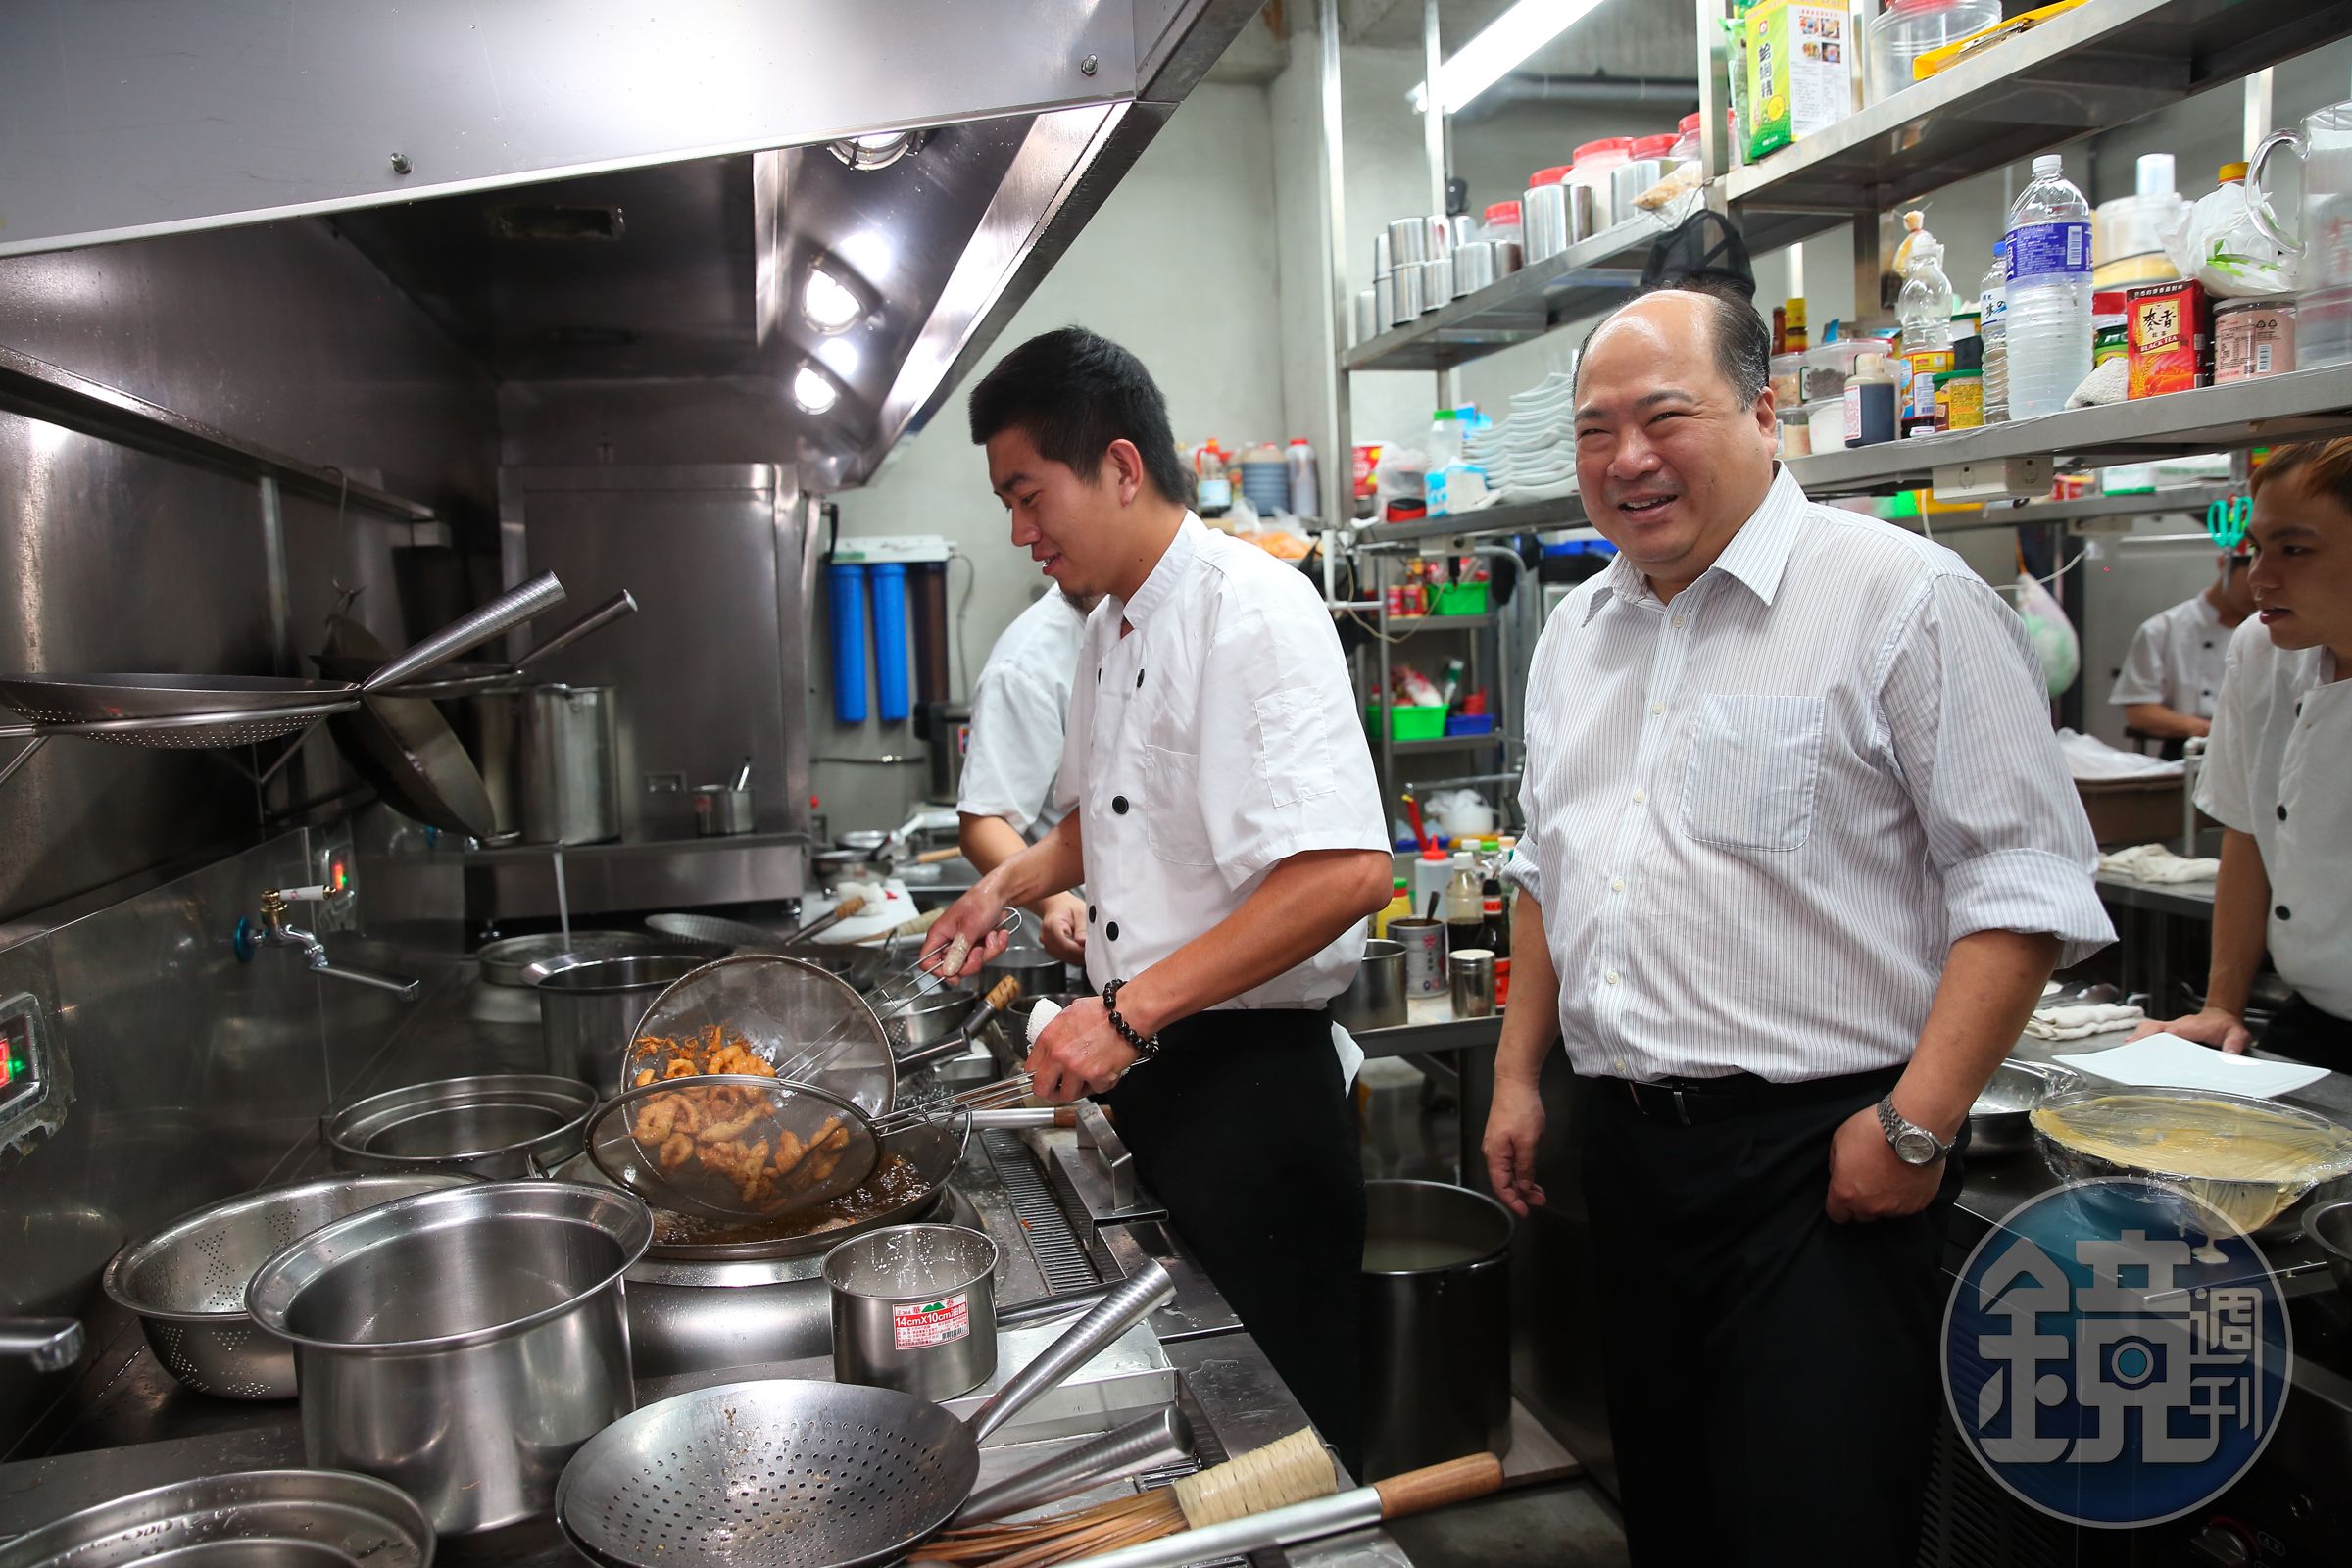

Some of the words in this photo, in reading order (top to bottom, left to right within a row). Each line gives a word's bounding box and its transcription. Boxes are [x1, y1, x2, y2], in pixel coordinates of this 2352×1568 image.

[2143, 308, 2177, 333] 麥香
[2140, 340, 2163, 352] BLACK
[2164, 335, 2178, 344] TEA
